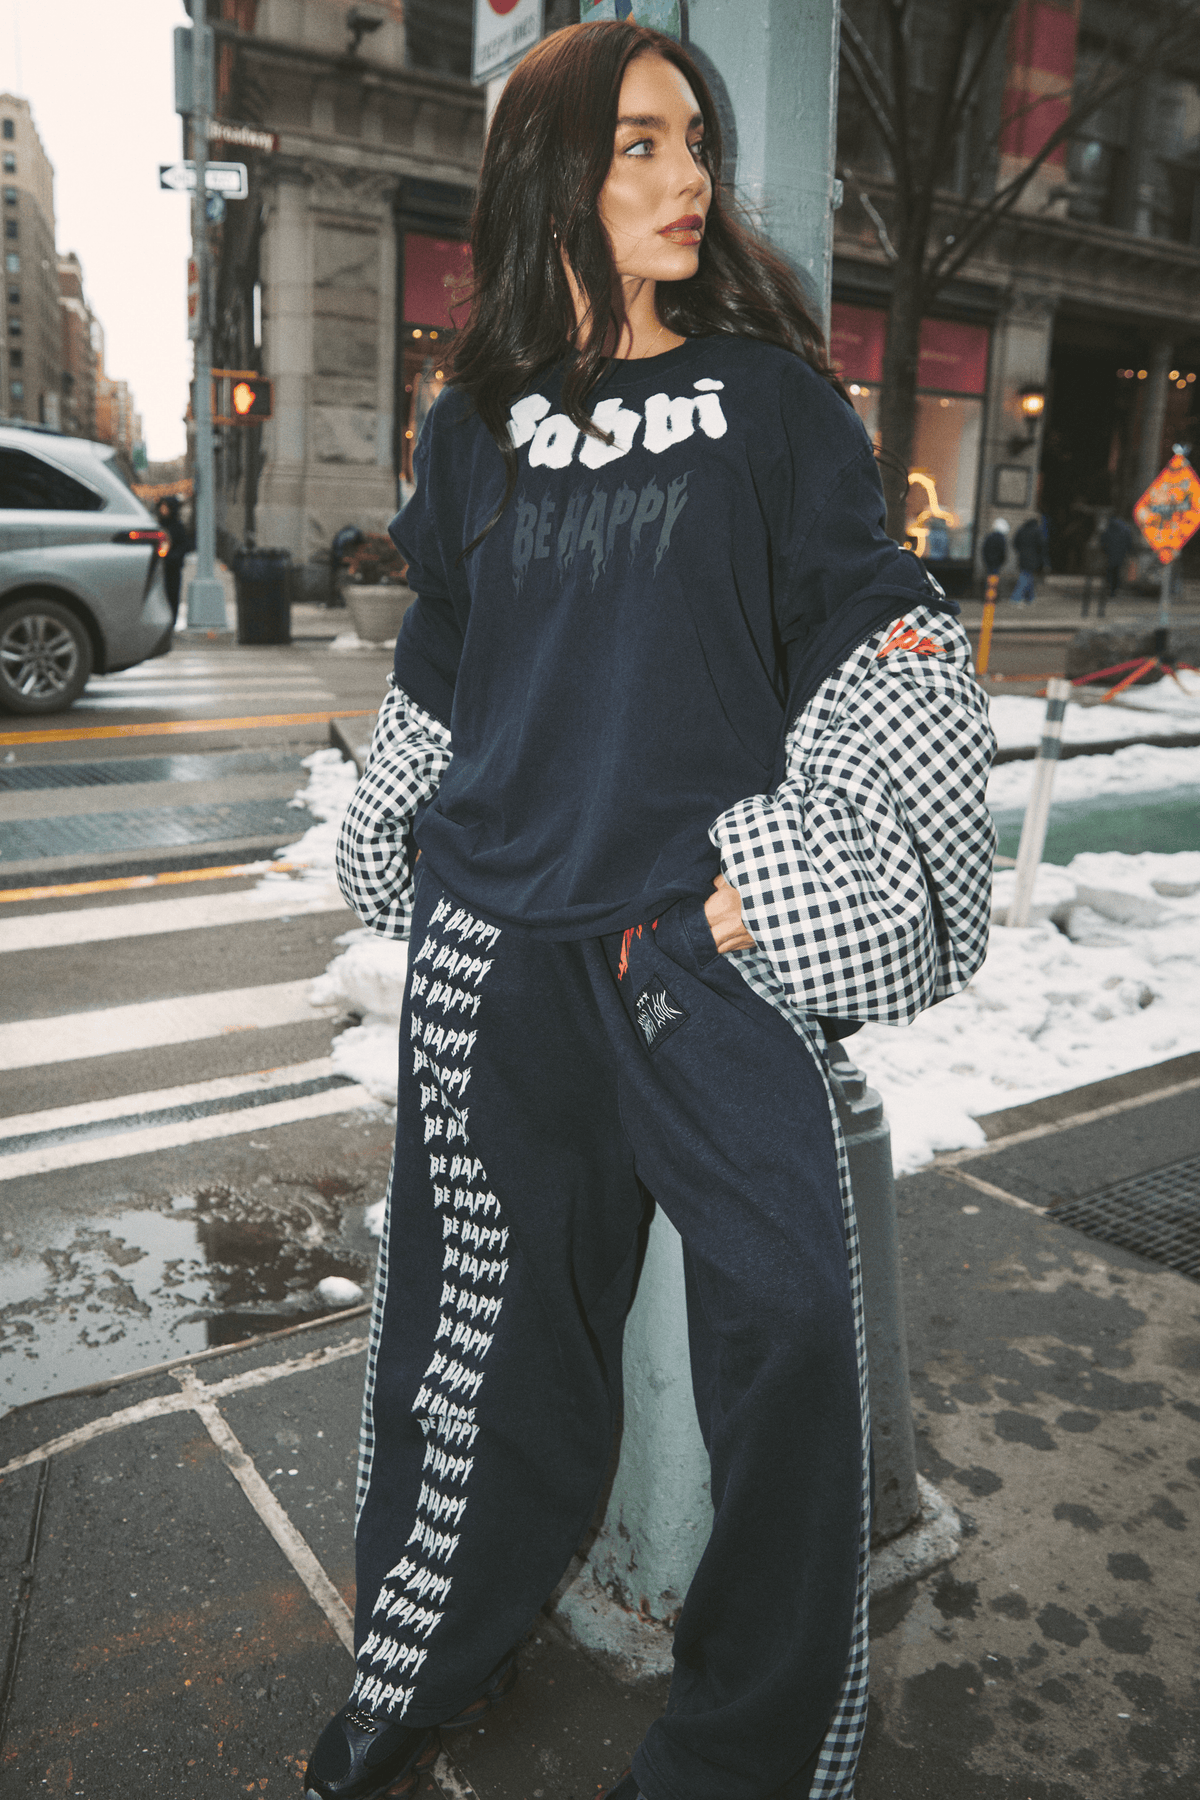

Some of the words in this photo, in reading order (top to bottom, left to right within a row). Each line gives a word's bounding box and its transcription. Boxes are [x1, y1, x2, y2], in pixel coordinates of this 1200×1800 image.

[511, 484, 556, 595] BE
[557, 469, 697, 593] HAPPY
[427, 896, 451, 928] BE
[443, 908, 502, 951] HAPPY
[413, 933, 437, 965] BE
[432, 944, 495, 988] HAPPY
[410, 969, 429, 1000] BE
[426, 980, 482, 1019] HAPPY
[410, 1010, 423, 1041] BE
[423, 1021, 479, 1062] HAPPY
[412, 1045, 429, 1076] BE
[420, 1081, 438, 1111] BE
[424, 1113, 444, 1145] BE
[429, 1151, 448, 1180] BE
[449, 1153, 487, 1186] HAP
[433, 1182, 451, 1209] BE
[442, 1213, 460, 1241] BE
[461, 1219, 510, 1254] HAPPY
[442, 1243, 460, 1271] BE
[459, 1251, 509, 1286] HAPPY
[439, 1279, 458, 1308] BE
[456, 1288, 504, 1327] HAPPY
[433, 1311, 454, 1342] BE
[423, 1348, 448, 1379] BE
[439, 1358, 486, 1402] HAPPY
[411, 1383, 433, 1413] BE
[416, 1416, 437, 1437] BE
[437, 1416, 480, 1451] HAPPY
[432, 1447, 475, 1488] HAPPY
[427, 1486, 469, 1529] HAPPY
[404, 1515, 426, 1548] BE
[421, 1525, 462, 1566] HAPPY
[383, 1555, 417, 1580] BE
[404, 1566, 454, 1607] HAPPY
[371, 1583, 396, 1619] BE
[386, 1596, 446, 1642] HAPPY
[356, 1627, 381, 1662] BE
[370, 1635, 428, 1680] HAPPY
[358, 1674, 417, 1721] HAPPY
